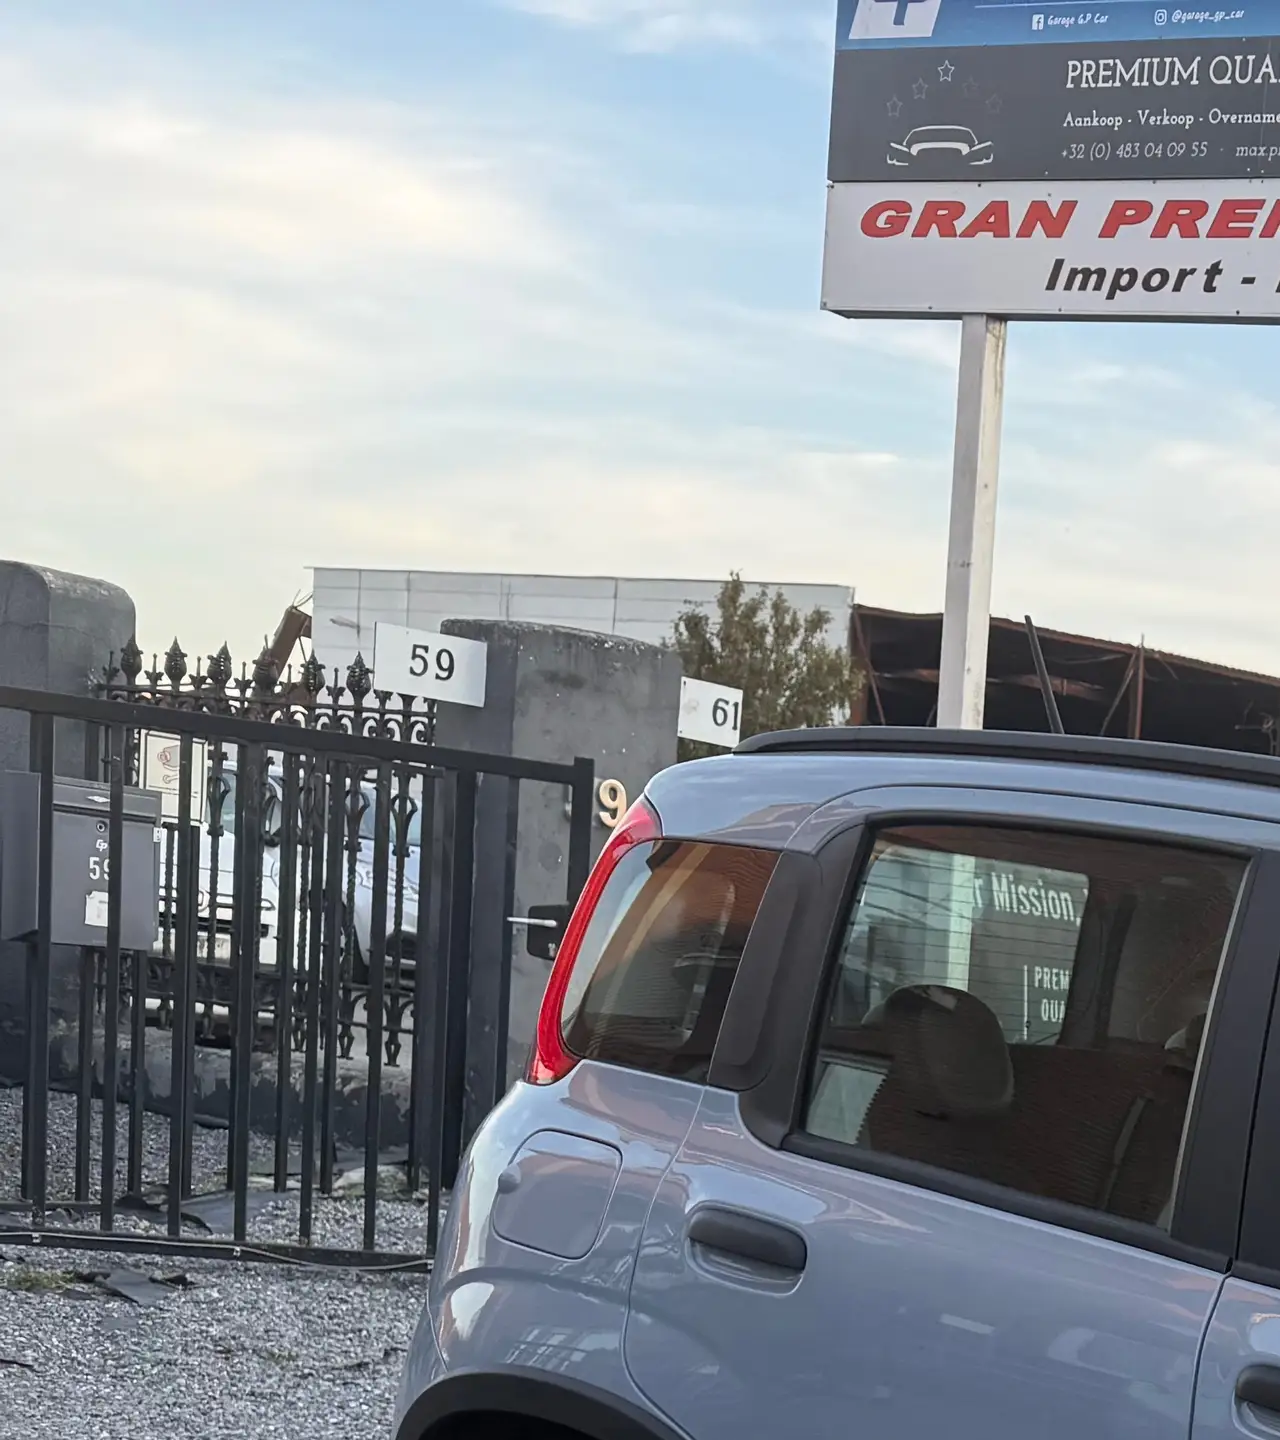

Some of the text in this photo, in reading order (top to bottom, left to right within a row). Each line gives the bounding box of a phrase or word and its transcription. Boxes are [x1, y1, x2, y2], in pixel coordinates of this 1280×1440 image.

[1048, 15, 1075, 27] Garage
[1095, 13, 1109, 24] Car
[1066, 56, 1200, 88] PREMIUM
[1063, 110, 1123, 130] Aankoop
[1137, 108, 1194, 128] Verkoop
[1061, 142, 1208, 161] +32 (0) 483 04 09 55
[859, 200, 1077, 240] GRAN
[1044, 258, 1224, 297] Import
[408, 644, 456, 681] 59
[711, 698, 740, 731] 61
